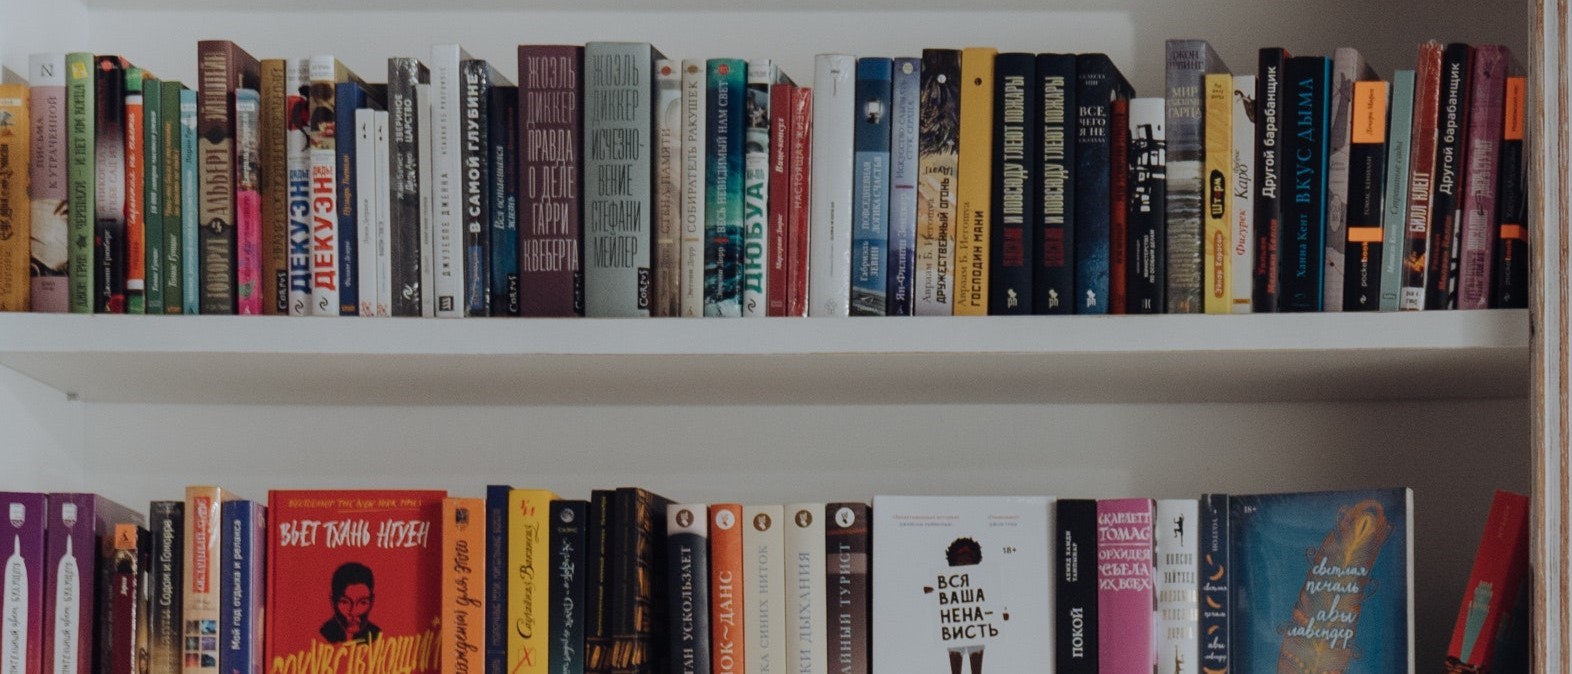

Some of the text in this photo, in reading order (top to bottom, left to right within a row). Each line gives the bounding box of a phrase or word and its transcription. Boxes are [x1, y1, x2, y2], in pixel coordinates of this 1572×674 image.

[528, 56, 575, 89] ЖОЭЛЬ
[593, 55, 639, 87] ЖОЭЛЬ
[395, 94, 403, 143] ЗВЕРИНОЕ
[404, 99, 413, 143] ЦАРСТВО
[527, 91, 575, 129] ДИККЕР
[591, 90, 639, 123] ДИККЕР
[1005, 76, 1024, 123] ПОЖАРЫ
[1045, 76, 1065, 123] ПОЖАРЫ
[35, 117, 44, 168] ПИСЬМА
[48, 96, 58, 178] УТРАЧЕННОЙ
[467, 74, 481, 217] САМОЙ ГЛУБИНЕ
[528, 130, 574, 166] ПРАВДА
[775, 118, 785, 173] Вице-консул
[1004, 126, 1023, 160] ТЛЕЮТ
[1045, 126, 1064, 160] ТЛЕЮТ
[1262, 66, 1277, 198] Другой барабанщик
[1296, 78, 1315, 204] ВКУС ДЫМА
[1439, 63, 1460, 195] Другой барабанщик
[687, 81, 698, 233] СОБИРАТЕЛЬ РАКУШЕК
[717, 80, 729, 232] ВЕСЬ НЕВИДИМЫЙ НАМ СВЕТ
[542, 166, 575, 202] ДЕЛЕ
[598, 165, 633, 196] ВЕНИЕ
[862, 161, 870, 229] ПОВСЕДНЕВНАЯ
[1004, 163, 1028, 214] ПОВСЮДУ
[1045, 163, 1069, 214] ПОВСЮДУ
[1234, 164, 1251, 200] Каро
[1409, 172, 1429, 232] БИЛЛ КЛЕГГ
[290, 180, 311, 294] ДЕКУЭН
[313, 178, 335, 291] ДЕКУЭН
[533, 203, 569, 235] ГАРРИ
[591, 201, 641, 233] СТЕФАНИ
[745, 182, 764, 294] ДЮБУА
[1236, 209, 1247, 256] Фигурек
[524, 239, 579, 271] КВЕБЕРТА
[593, 232, 638, 268] МЕЙЛЕР
[860, 241, 869, 281] Габриэль
[870, 247, 879, 276] ЗЕВИН
[936, 178, 949, 304] ДРУЖЕСТВЕННЫЙ ОГОНЬ
[958, 202, 970, 306] Авраам Иегошуа
[971, 211, 984, 307] ГОСПОДИН МАНИ
[1297, 213, 1308, 277] Ханна Кент
[1360, 241, 1369, 287] pocketbook
[896, 239, 906, 301] Ян-Филипп
[923, 263, 932, 303] Авраам
[280, 519, 430, 548] ВЬЕТ ТХАНЬ НГУЕН
[1099, 550, 1150, 559] ОРХИДЕЯ
[1100, 527, 1150, 541] ТОМАС
[159, 573, 173, 605] Содом
[232, 520, 242, 650] Мой год отдыха релакса
[839, 542, 851, 607] ТУРИСТ
[938, 574, 969, 589] ВСЯ
[1099, 564, 1149, 576] СЪЕЛА
[1100, 579, 1149, 591] ИХ ВСЕХ
[1306, 577, 1359, 594] печаль
[1313, 557, 1368, 577] светлая
[681, 545, 693, 641] УСКОЛЬЗАЕТ
[759, 545, 769, 648] СИНИХ НИТОК
[798, 552, 813, 643] ДЫХАНИЯ
[939, 589, 985, 604] ВАША
[940, 607, 993, 623] НЕНА-
[942, 625, 999, 641] ВИСТЬ
[1072, 607, 1083, 658] ПОКОЙ
